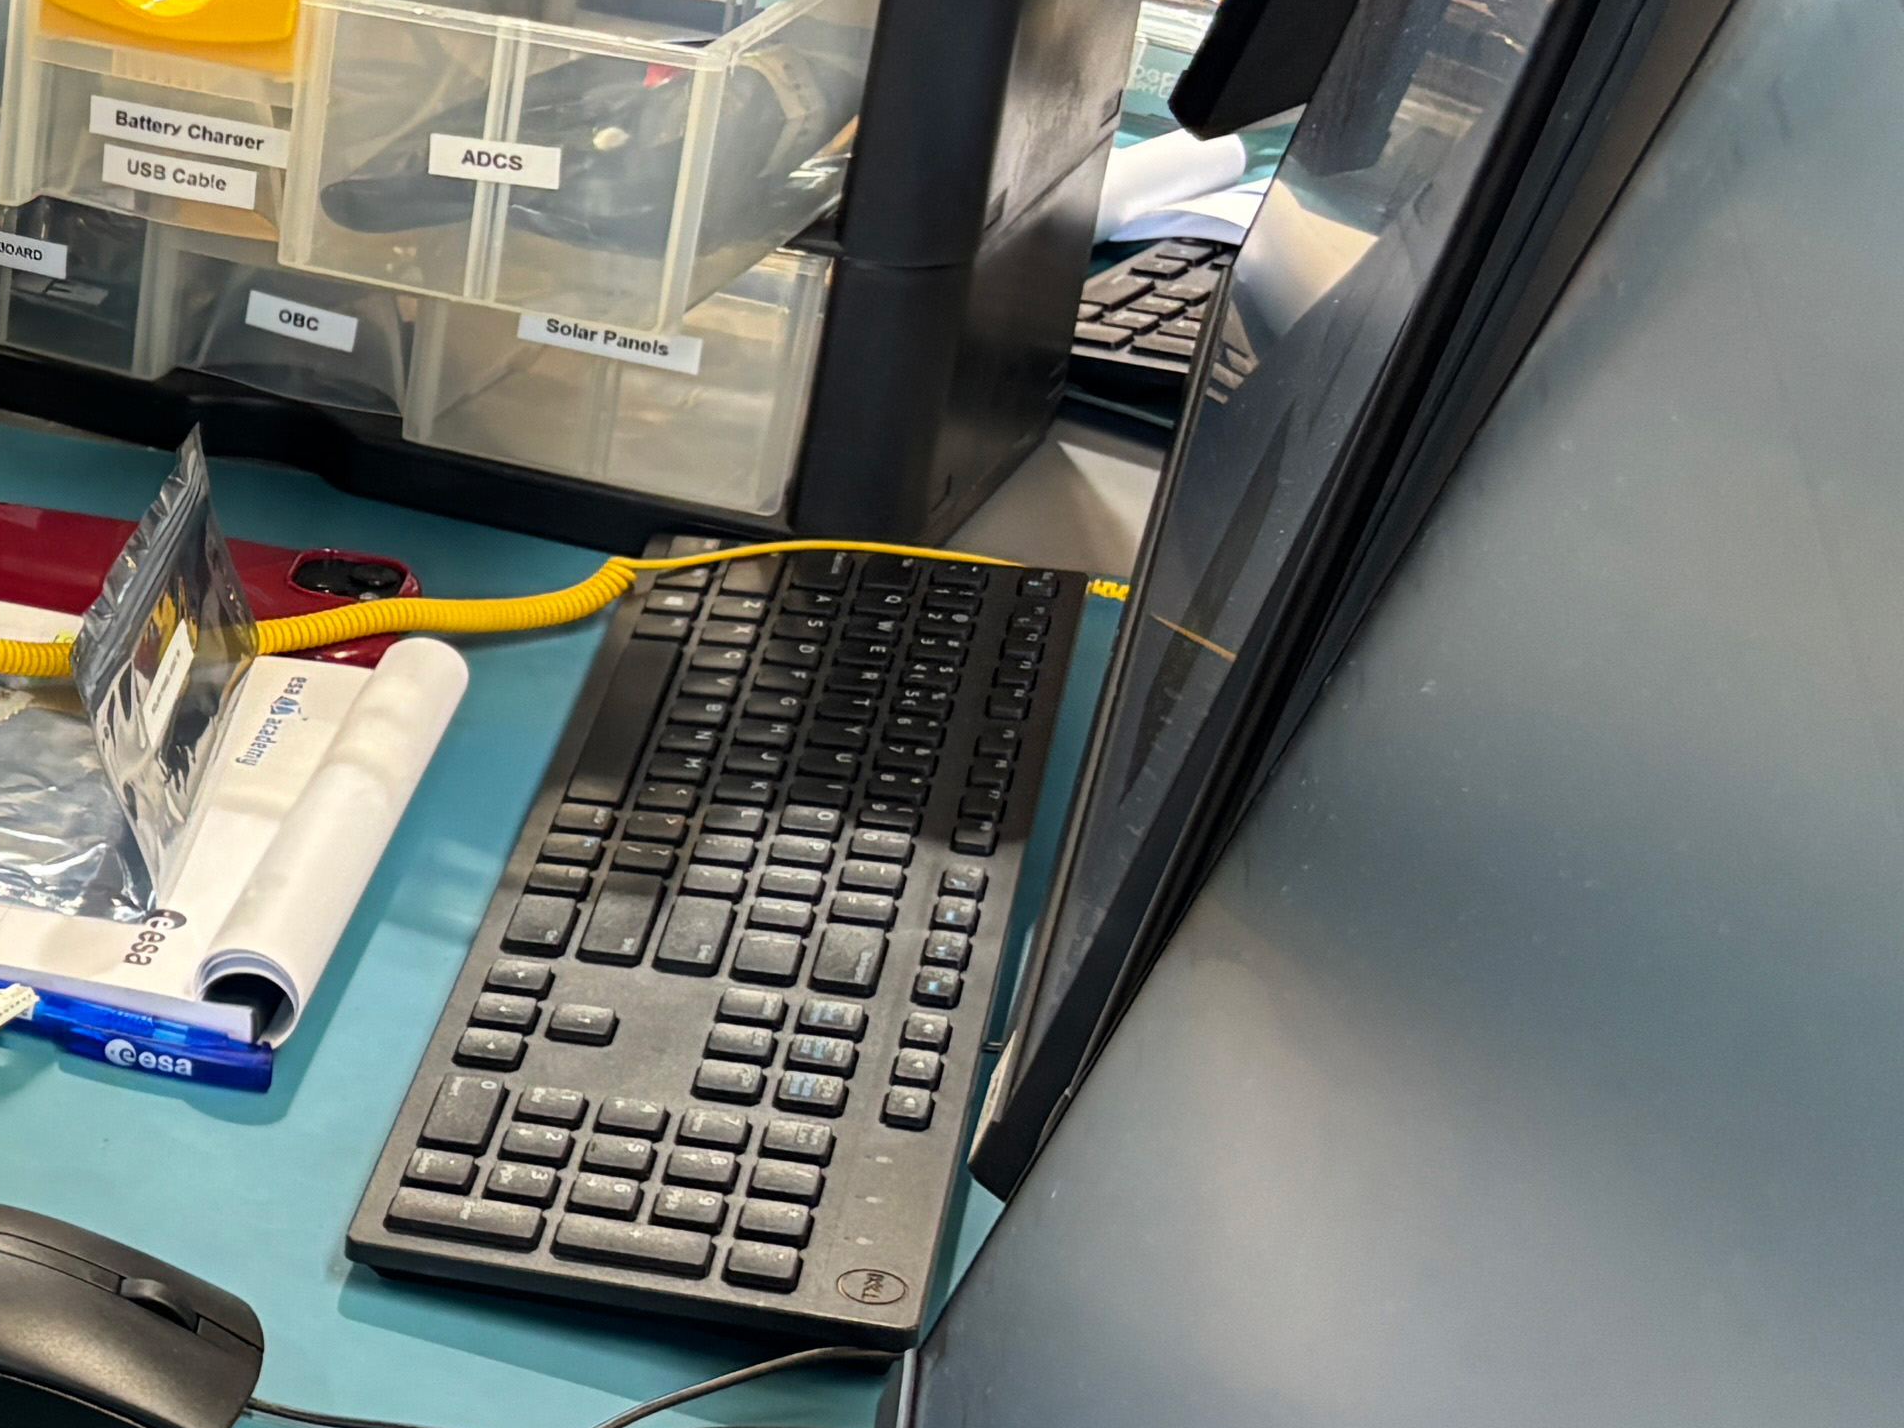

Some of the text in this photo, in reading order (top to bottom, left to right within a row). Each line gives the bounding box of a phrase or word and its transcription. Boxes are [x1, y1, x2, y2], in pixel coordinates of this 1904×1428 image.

[115, 110, 265, 153] Battery Charger
[126, 158, 228, 192] USB Cable
[461, 148, 524, 172] ADCS
[278, 308, 320, 332] OBC
[546, 317, 670, 358] Solar Panels
[236, 675, 308, 767] esa academy
[138, 1050, 193, 1076] esa
